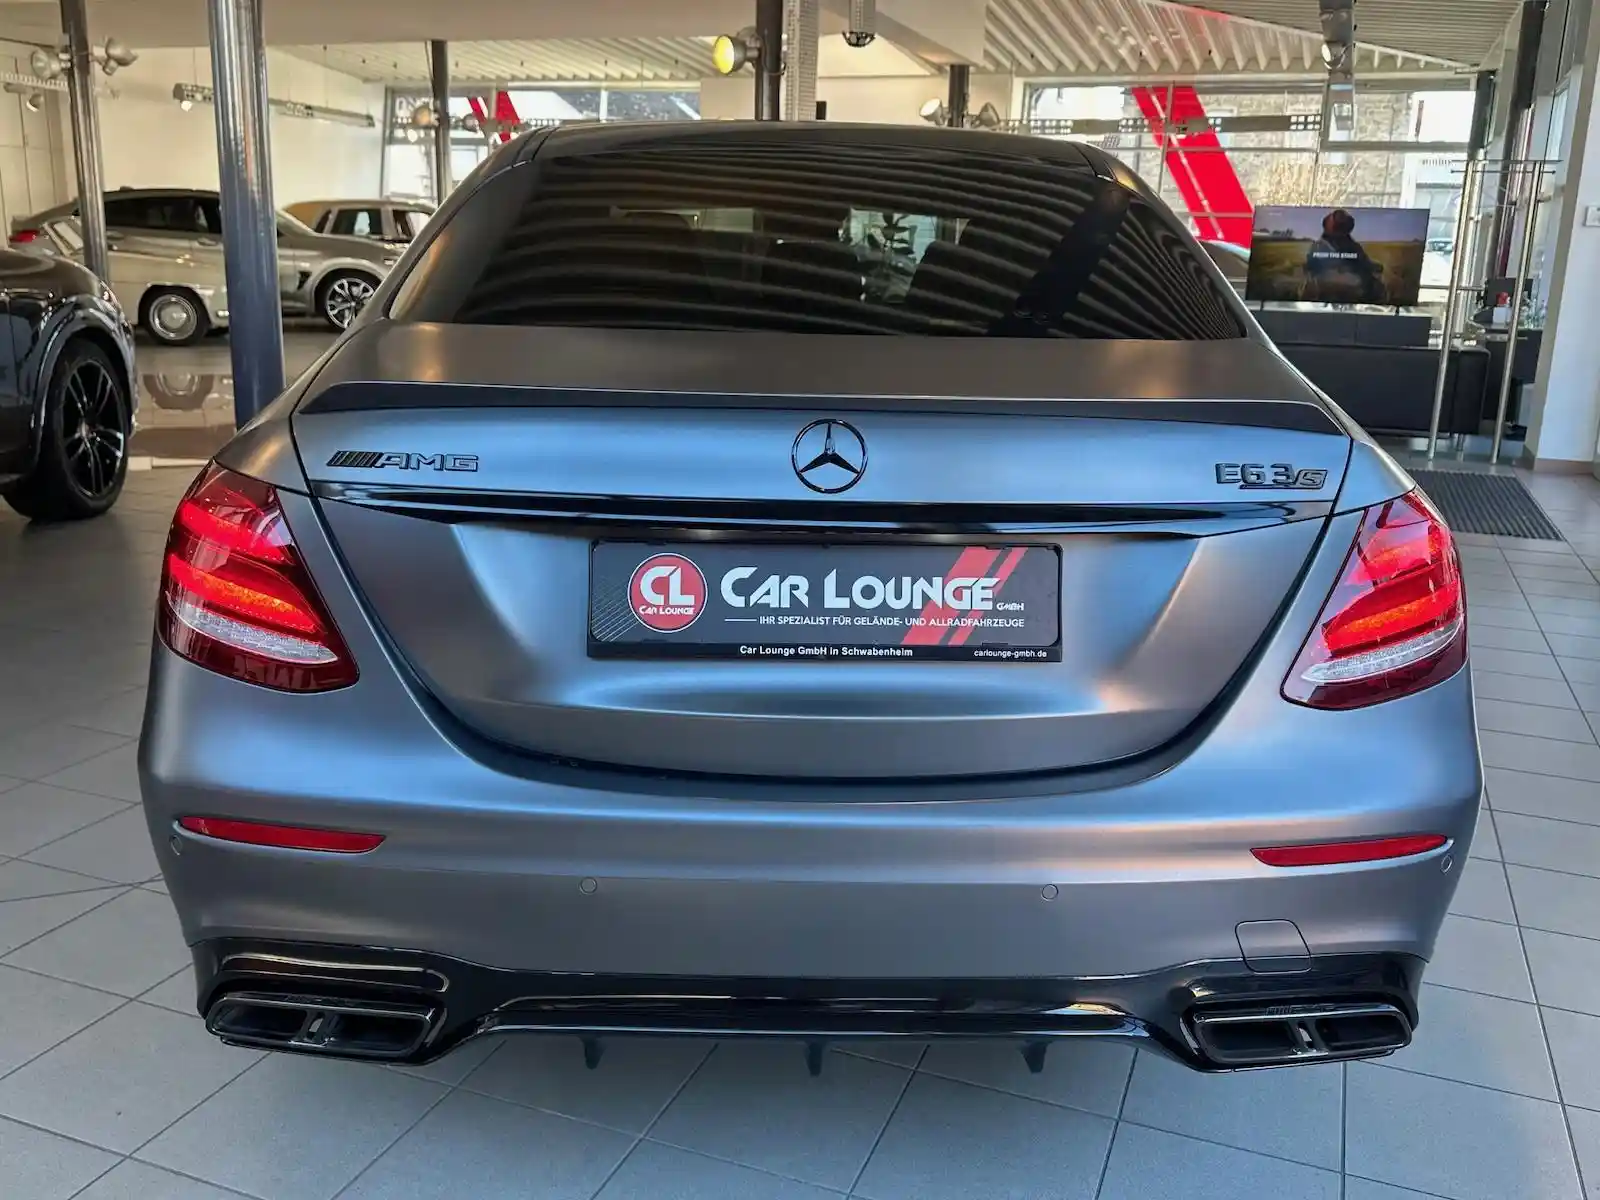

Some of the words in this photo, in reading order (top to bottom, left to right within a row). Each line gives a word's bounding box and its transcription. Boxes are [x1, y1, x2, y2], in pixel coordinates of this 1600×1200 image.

[371, 452, 479, 472] AMG
[640, 565, 695, 606] CL
[721, 566, 809, 608] CAR
[823, 568, 1001, 610] LOUNGE
[638, 605, 658, 615] CAR
[659, 606, 695, 616] LOUNGE
[758, 615, 776, 625] IHR
[777, 615, 830, 626] SPEZIALIST
[832, 614, 852, 627] FÜR
[853, 615, 904, 627] GELÄNDE-
[904, 617, 928, 627] UND
[928, 617, 1025, 628] ALLRADFAHRZEUGE
[739, 645, 758, 655] Car
[759, 645, 796, 657] Lounge
[797, 646, 828, 656] GmbH
[829, 646, 840, 656] in
[841, 646, 914, 657] Schwabenheim
[973, 649, 1048, 659] carlounge-gmbh.de
